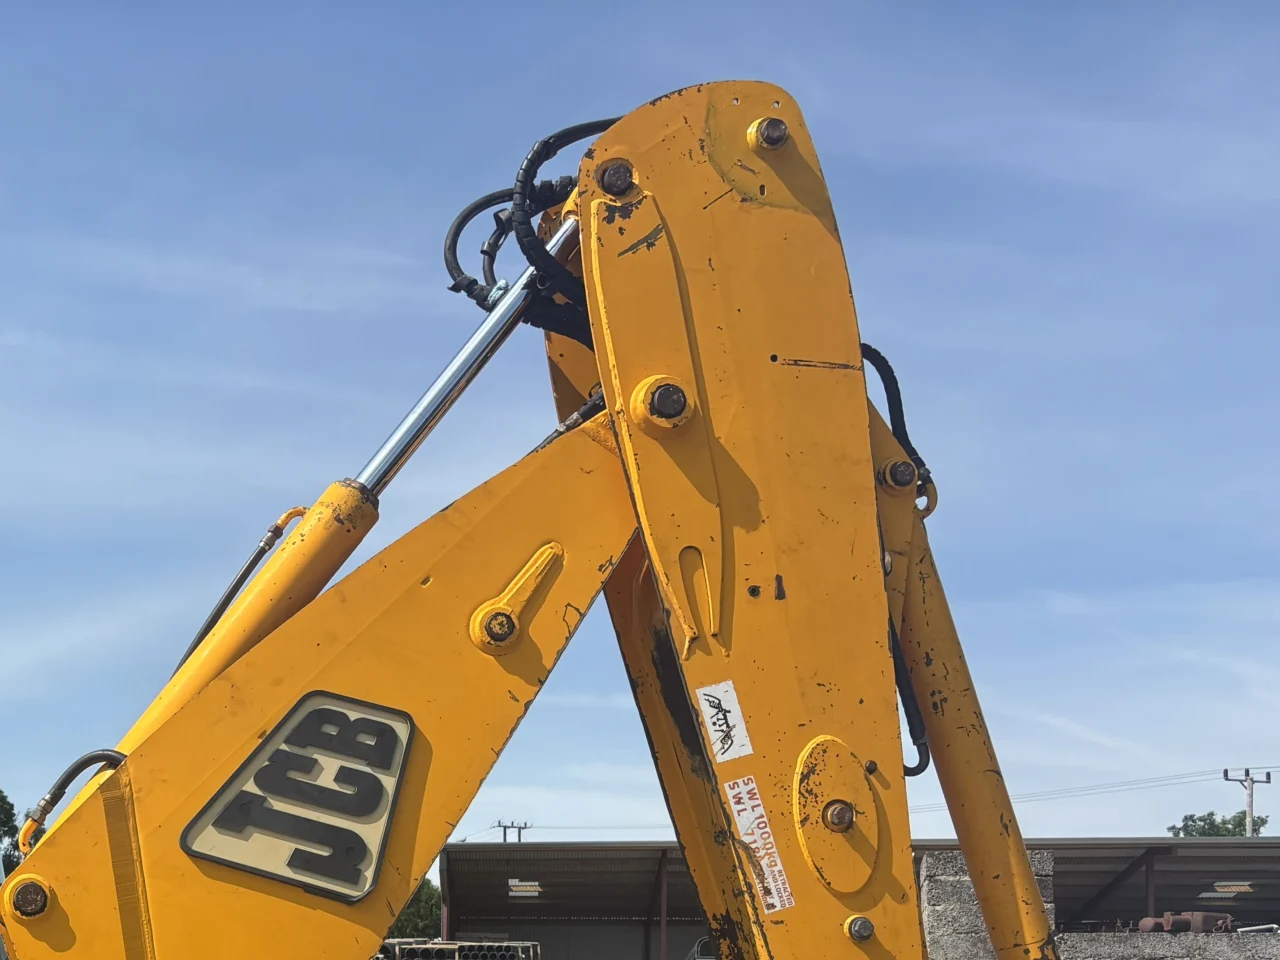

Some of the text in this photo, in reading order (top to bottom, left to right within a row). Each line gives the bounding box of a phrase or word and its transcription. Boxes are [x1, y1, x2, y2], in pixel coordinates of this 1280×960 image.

[210, 707, 398, 886] JCB
[728, 781, 748, 817] SWL
[742, 777, 762, 813] SWL
[769, 869, 787, 908] AND LOCKED
[776, 869, 794, 906] RETRACTED
